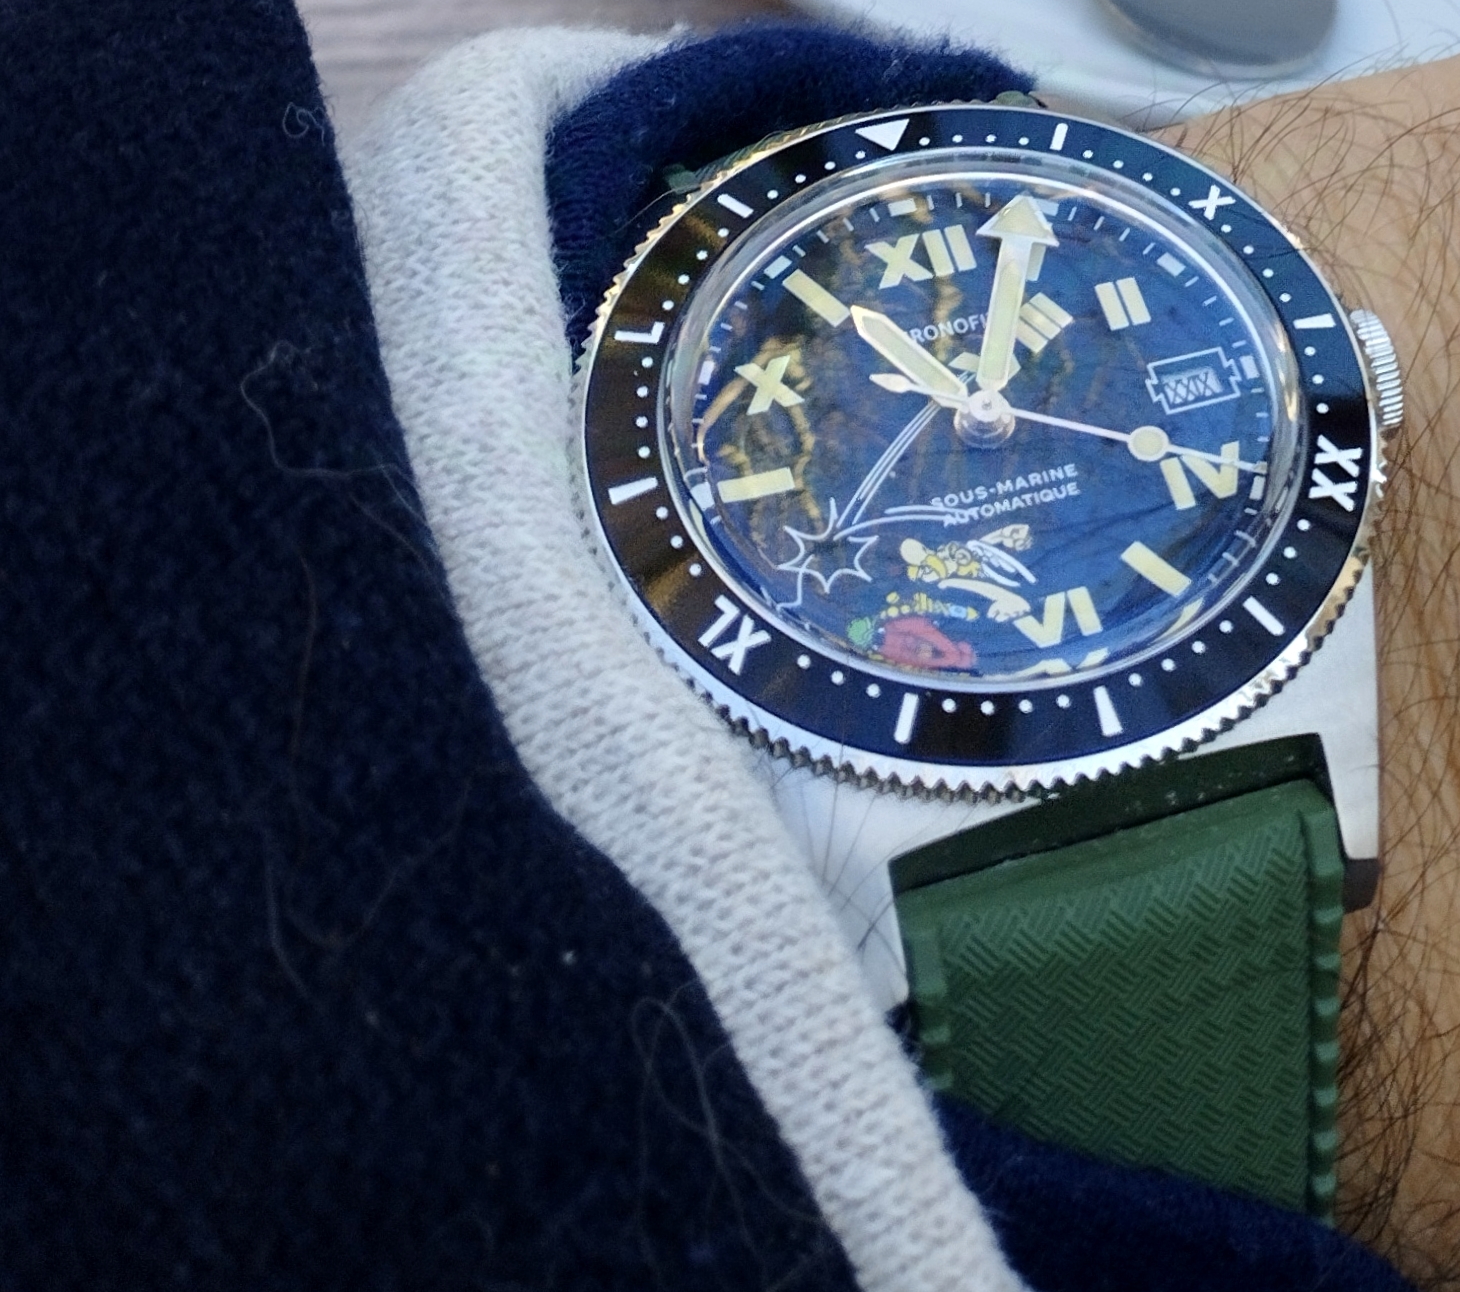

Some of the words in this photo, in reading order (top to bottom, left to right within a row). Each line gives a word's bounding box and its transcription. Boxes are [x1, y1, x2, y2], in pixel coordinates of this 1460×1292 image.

[1188, 184, 1236, 220] X
[864, 224, 977, 290] XII
[908, 313, 988, 343] RONOFI
[734, 355, 805, 415] X
[930, 463, 1079, 508] SOUS-MARINE
[1160, 441, 1240, 510] IV
[1308, 434, 1363, 512] XX
[943, 481, 1081, 528] AUTOMATIQUE
[698, 595, 772, 675] XL
[1012, 586, 1103, 648] VI
